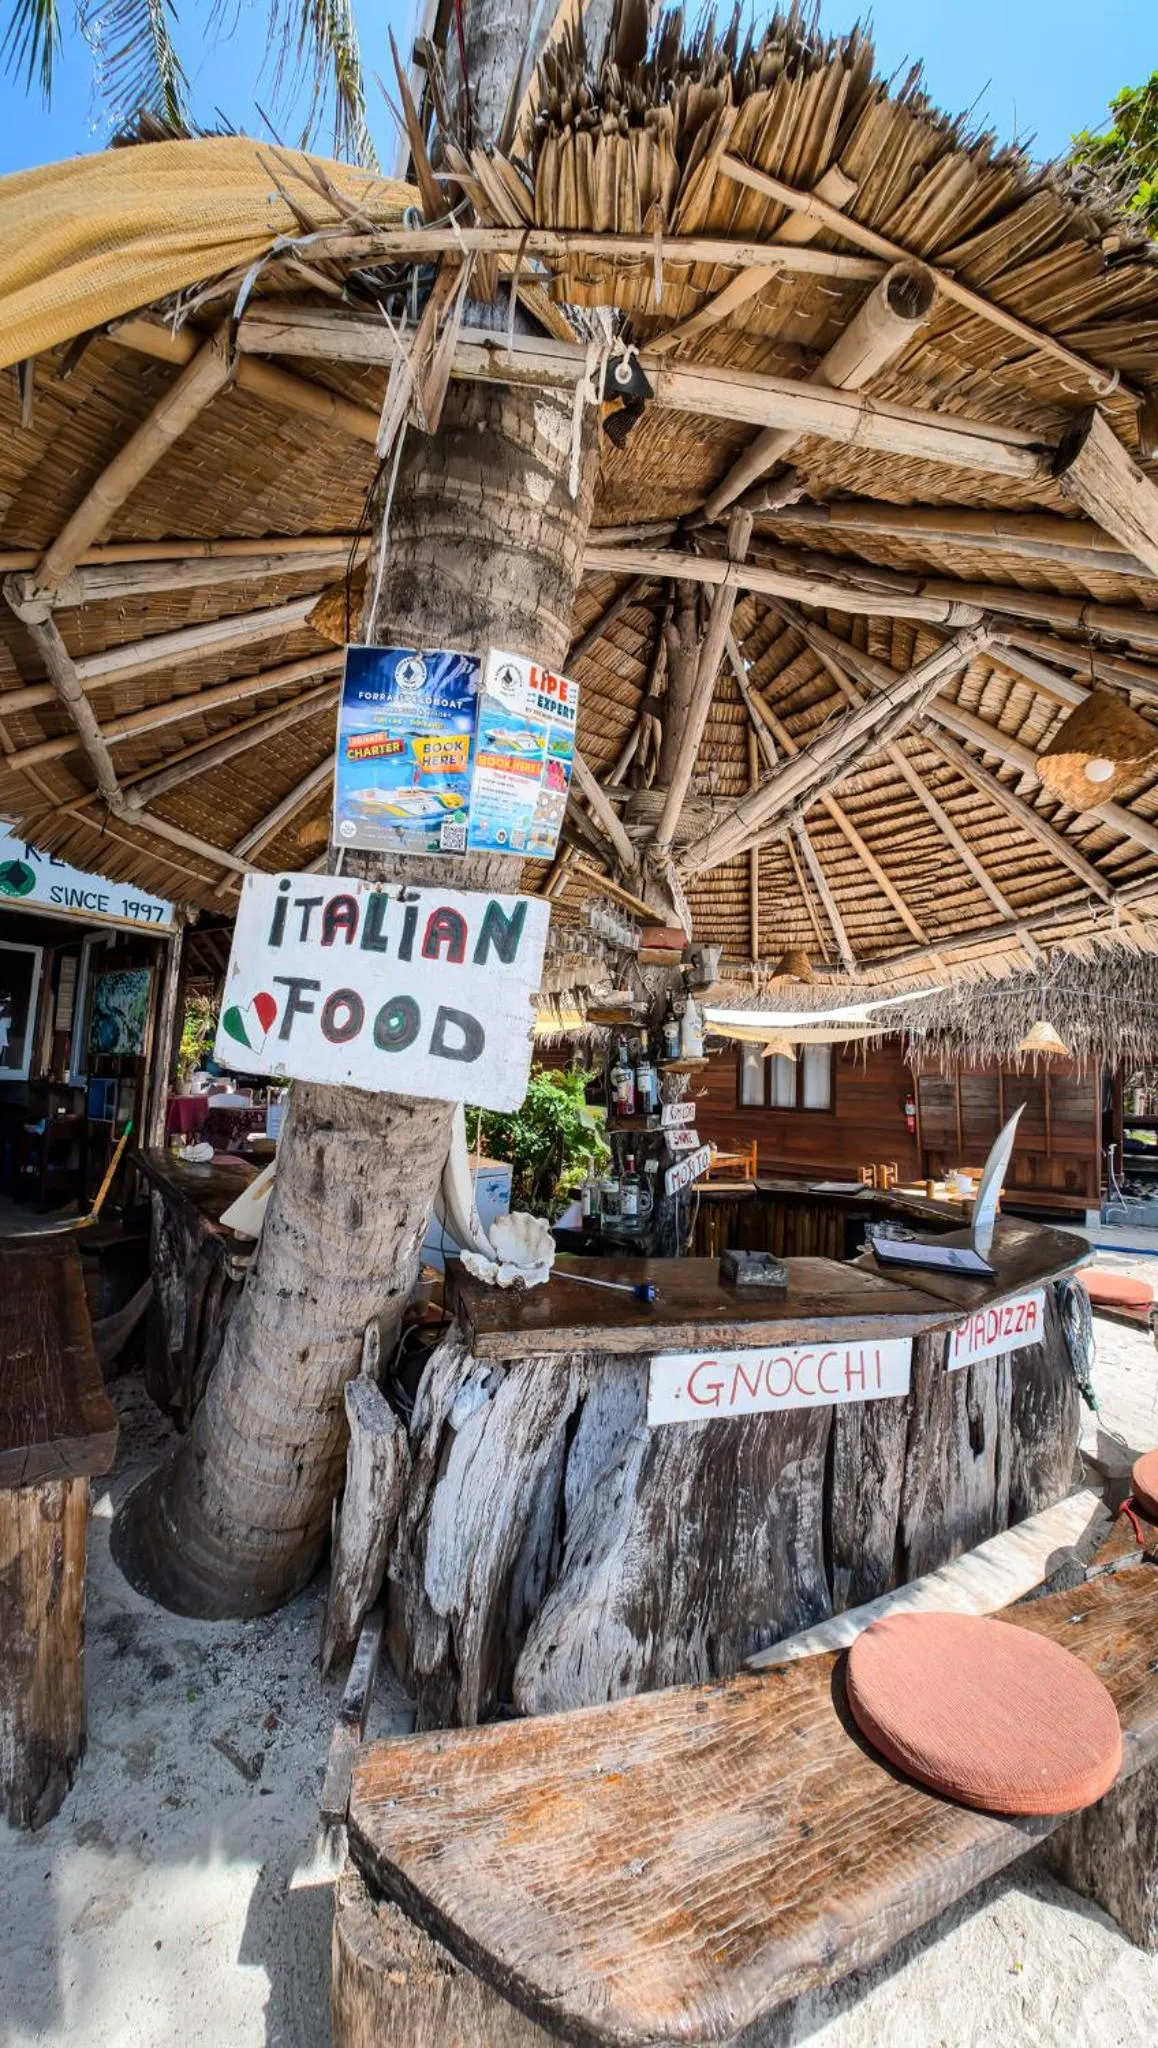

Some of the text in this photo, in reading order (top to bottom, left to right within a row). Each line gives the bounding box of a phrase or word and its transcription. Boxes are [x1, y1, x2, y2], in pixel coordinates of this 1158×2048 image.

[358, 691, 393, 702] FORRA
[529, 666, 569, 701] LIPE
[537, 694, 575, 720] EXPERT
[347, 742, 400, 760] CHARTER
[423, 741, 463, 753] BOOK
[479, 755, 510, 769] BOOK
[50, 886, 110, 912] SINCE
[122, 899, 164, 922] 1997
[267, 878, 528, 965] ITALIAN
[273, 976, 486, 1062] FOOD
[955, 1301, 1039, 1357] PIADIZZA
[686, 1350, 882, 1407] GNOCCHI
